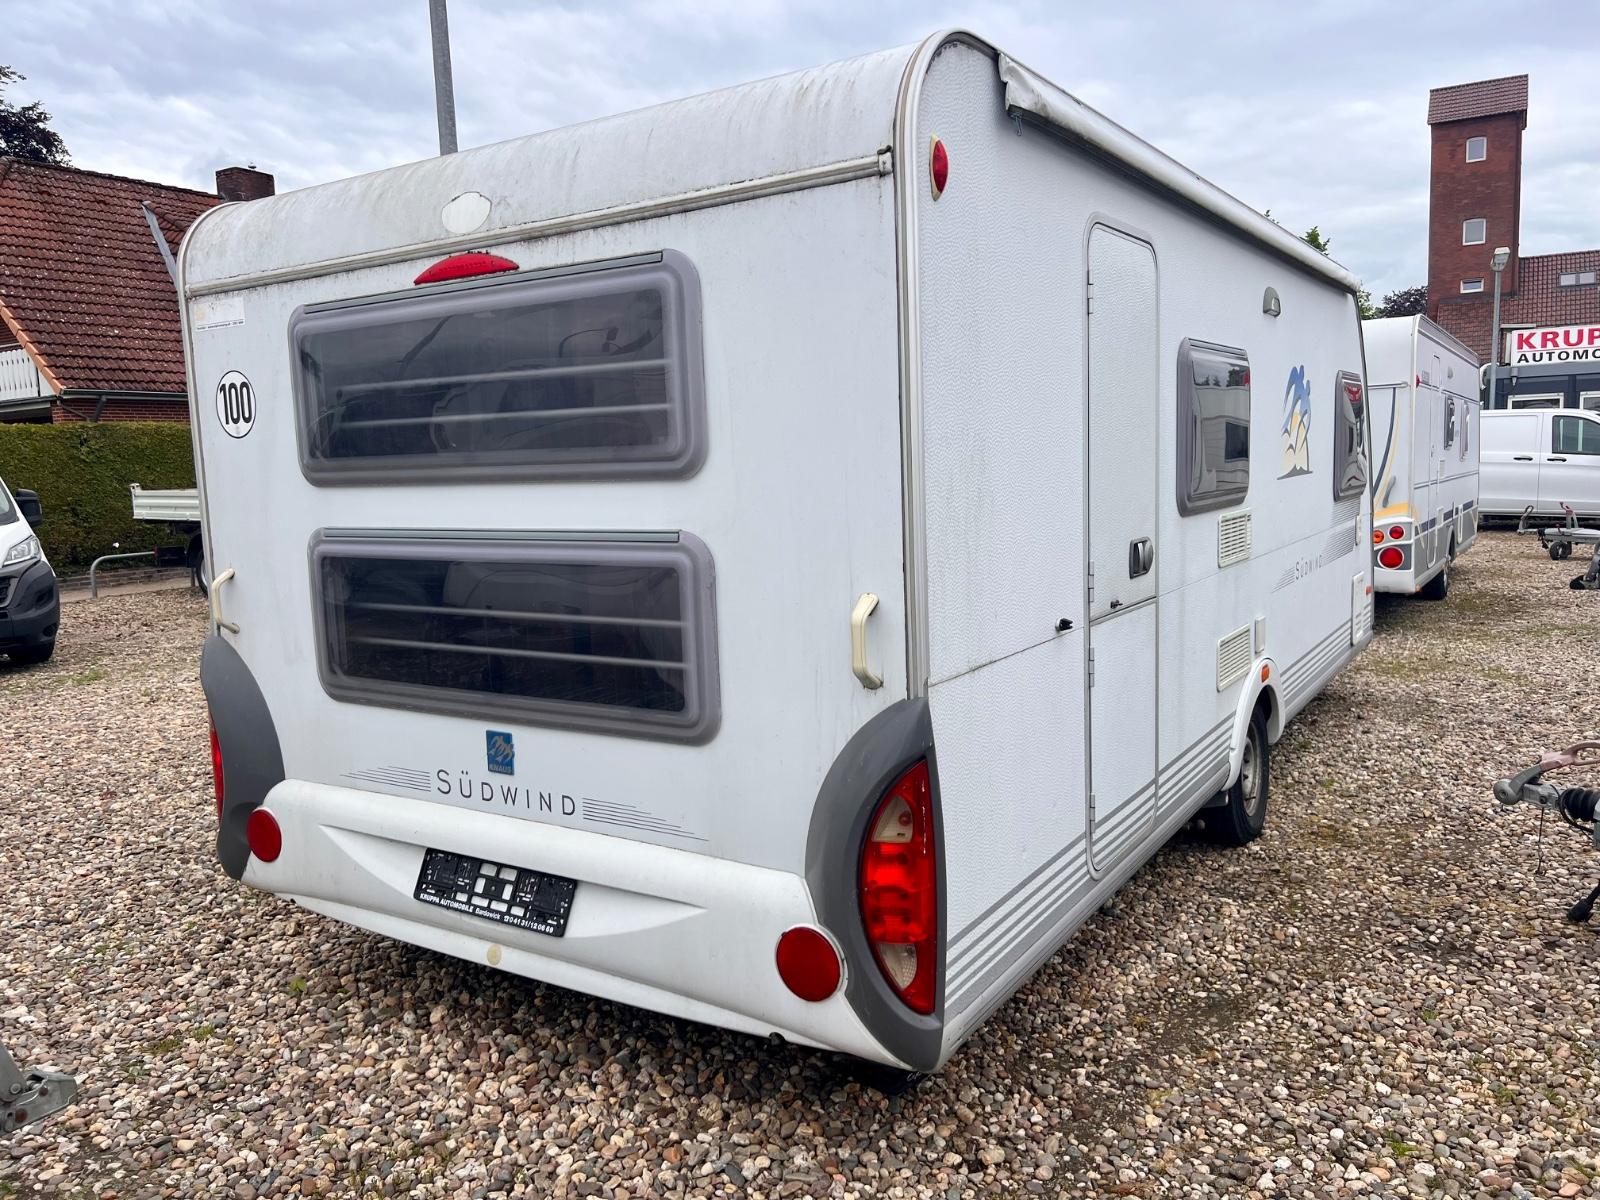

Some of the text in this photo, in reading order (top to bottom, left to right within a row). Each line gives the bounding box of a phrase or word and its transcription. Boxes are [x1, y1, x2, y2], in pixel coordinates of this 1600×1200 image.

[1517, 328, 1600, 350] KRUP
[220, 381, 253, 425] 100
[436, 769, 576, 816] SÜDWIND
[440, 898, 474, 913] AUTOMOBILE
